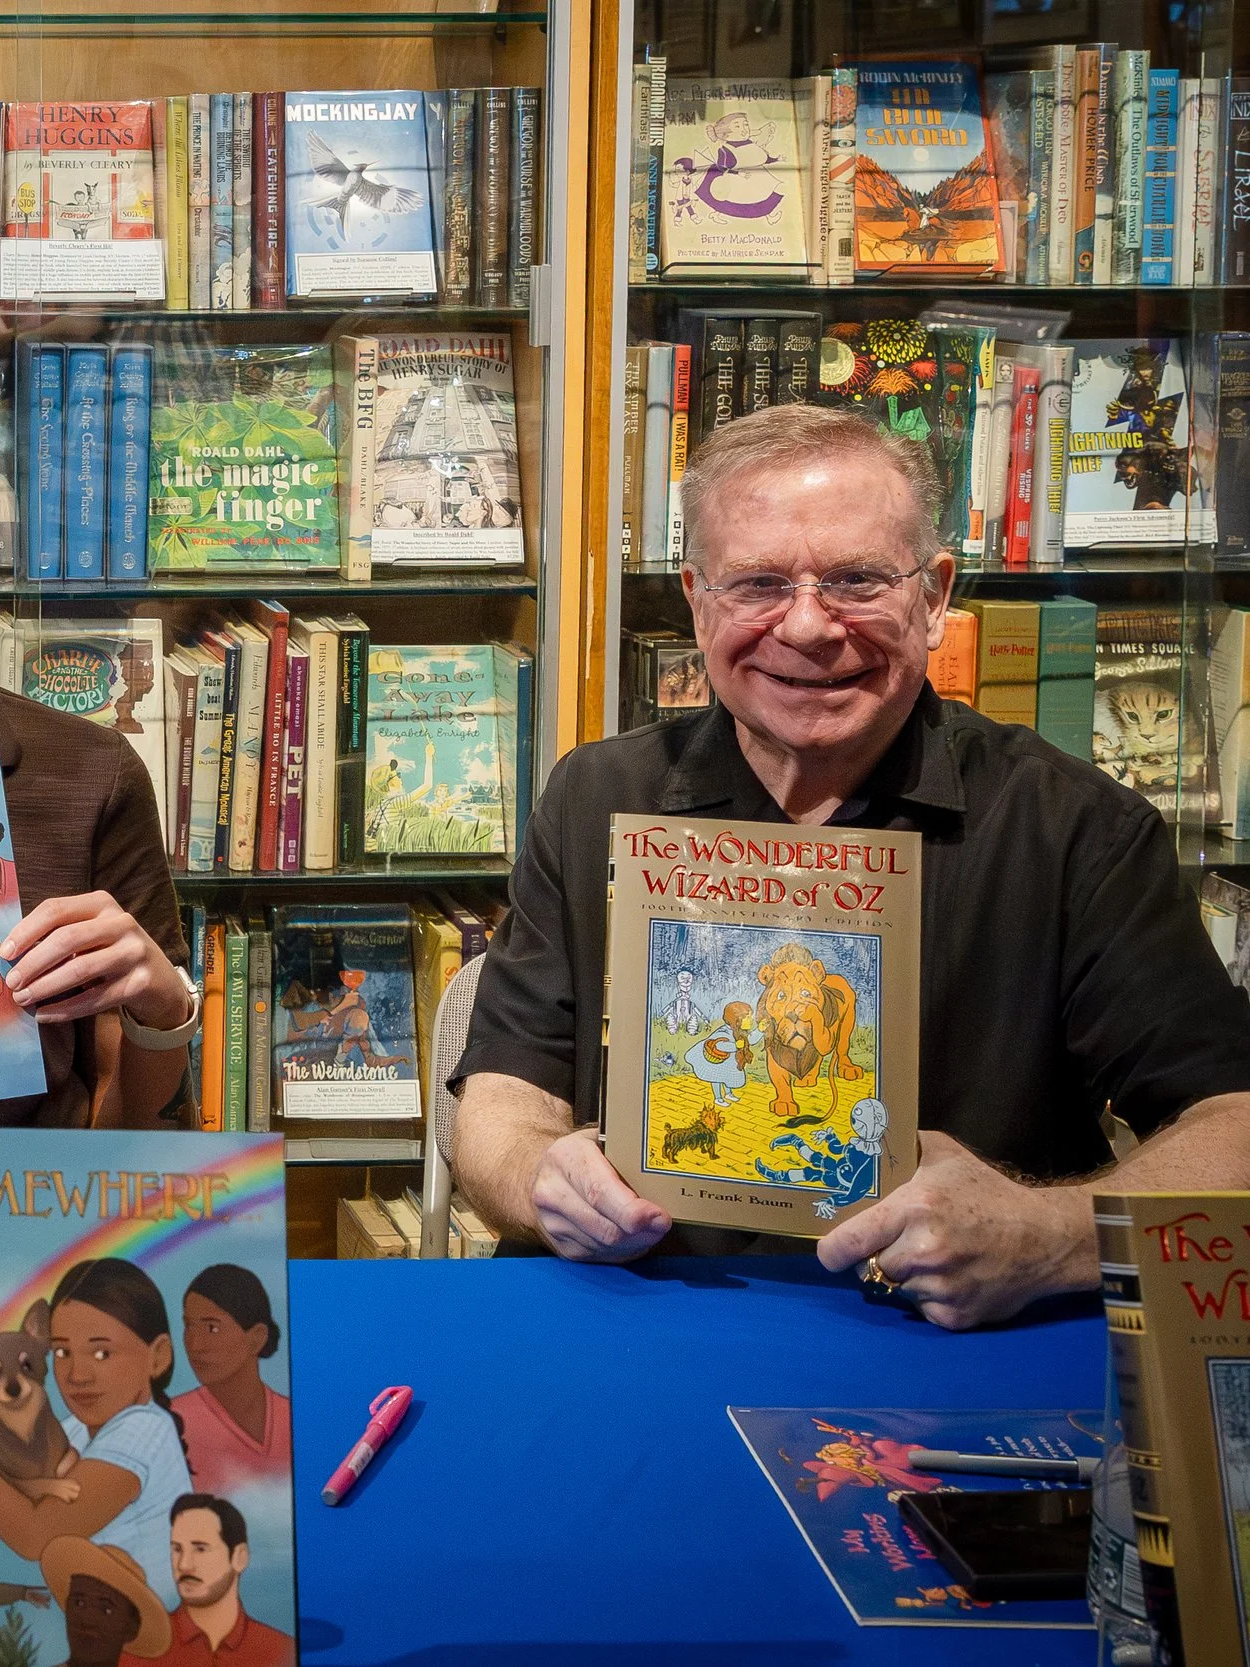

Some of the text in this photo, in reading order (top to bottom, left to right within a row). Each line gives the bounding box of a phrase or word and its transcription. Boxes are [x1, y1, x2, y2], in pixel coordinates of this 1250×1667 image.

[40, 106, 123, 123] HENRY
[287, 103, 417, 121] MOCKINGJAY
[640, 86, 649, 141] Earthfasts
[25, 128, 134, 146] HUGGINS
[866, 128, 968, 146] SWORD
[1131, 108, 1143, 176] The Outlaws
[1084, 107, 1097, 192] HOMER PRICE
[38, 160, 133, 169] BEVERLY CLEARY
[648, 155, 658, 184] ANNE
[20, 188, 35, 198] BUS
[20, 199, 36, 207] STOP
[267, 148, 277, 248] CATCHING FIRE
[701, 235, 725, 244] BETTY
[450, 338, 510, 364] DAHL
[392, 364, 482, 380] HENRY SUGAR
[393, 354, 492, 373] WONDERFUL STORY
[718, 357, 733, 390] THE
[674, 360, 689, 472] PULLMAN WAS RAT!
[357, 349, 375, 508] The BFG DAHL/BLAKE
[192, 446, 285, 458] ROALD DAHL
[160, 455, 319, 495] the magic
[1047, 418, 1064, 514] LIGHTNING THIEF
[216, 490, 322, 531] finger
[192, 537, 237, 545] WILLIAM
[352, 639, 360, 662] Beyond
[1012, 645, 1035, 656] Potter
[1111, 643, 1145, 655] TIMES
[32, 650, 104, 676] CHARLIE
[1094, 660, 1135, 680] George
[204, 676, 222, 687] Show
[376, 671, 485, 684] Cone-
[318, 690, 326, 720] SHALL
[382, 689, 476, 707] Away
[381, 704, 477, 725] Lake
[317, 721, 325, 750] ABIDE
[378, 728, 480, 743] Elizabeth Enright
[220, 712, 235, 792] The Great American
[269, 693, 283, 807] LITTLE BO FRANCE
[287, 746, 304, 800] PET
[624, 827, 910, 876] The WONDERFUL
[642, 865, 885, 914] WIZARD of OZ
[823, 917, 894, 929] EDITION
[207, 935, 215, 976] GRENDEL
[230, 943, 245, 1065] The OWL SERVICE
[283, 1060, 398, 1080] The Weirdstone
[680, 1188, 794, 1209] L. Frank Baum
[1145, 1213, 1234, 1263] The
